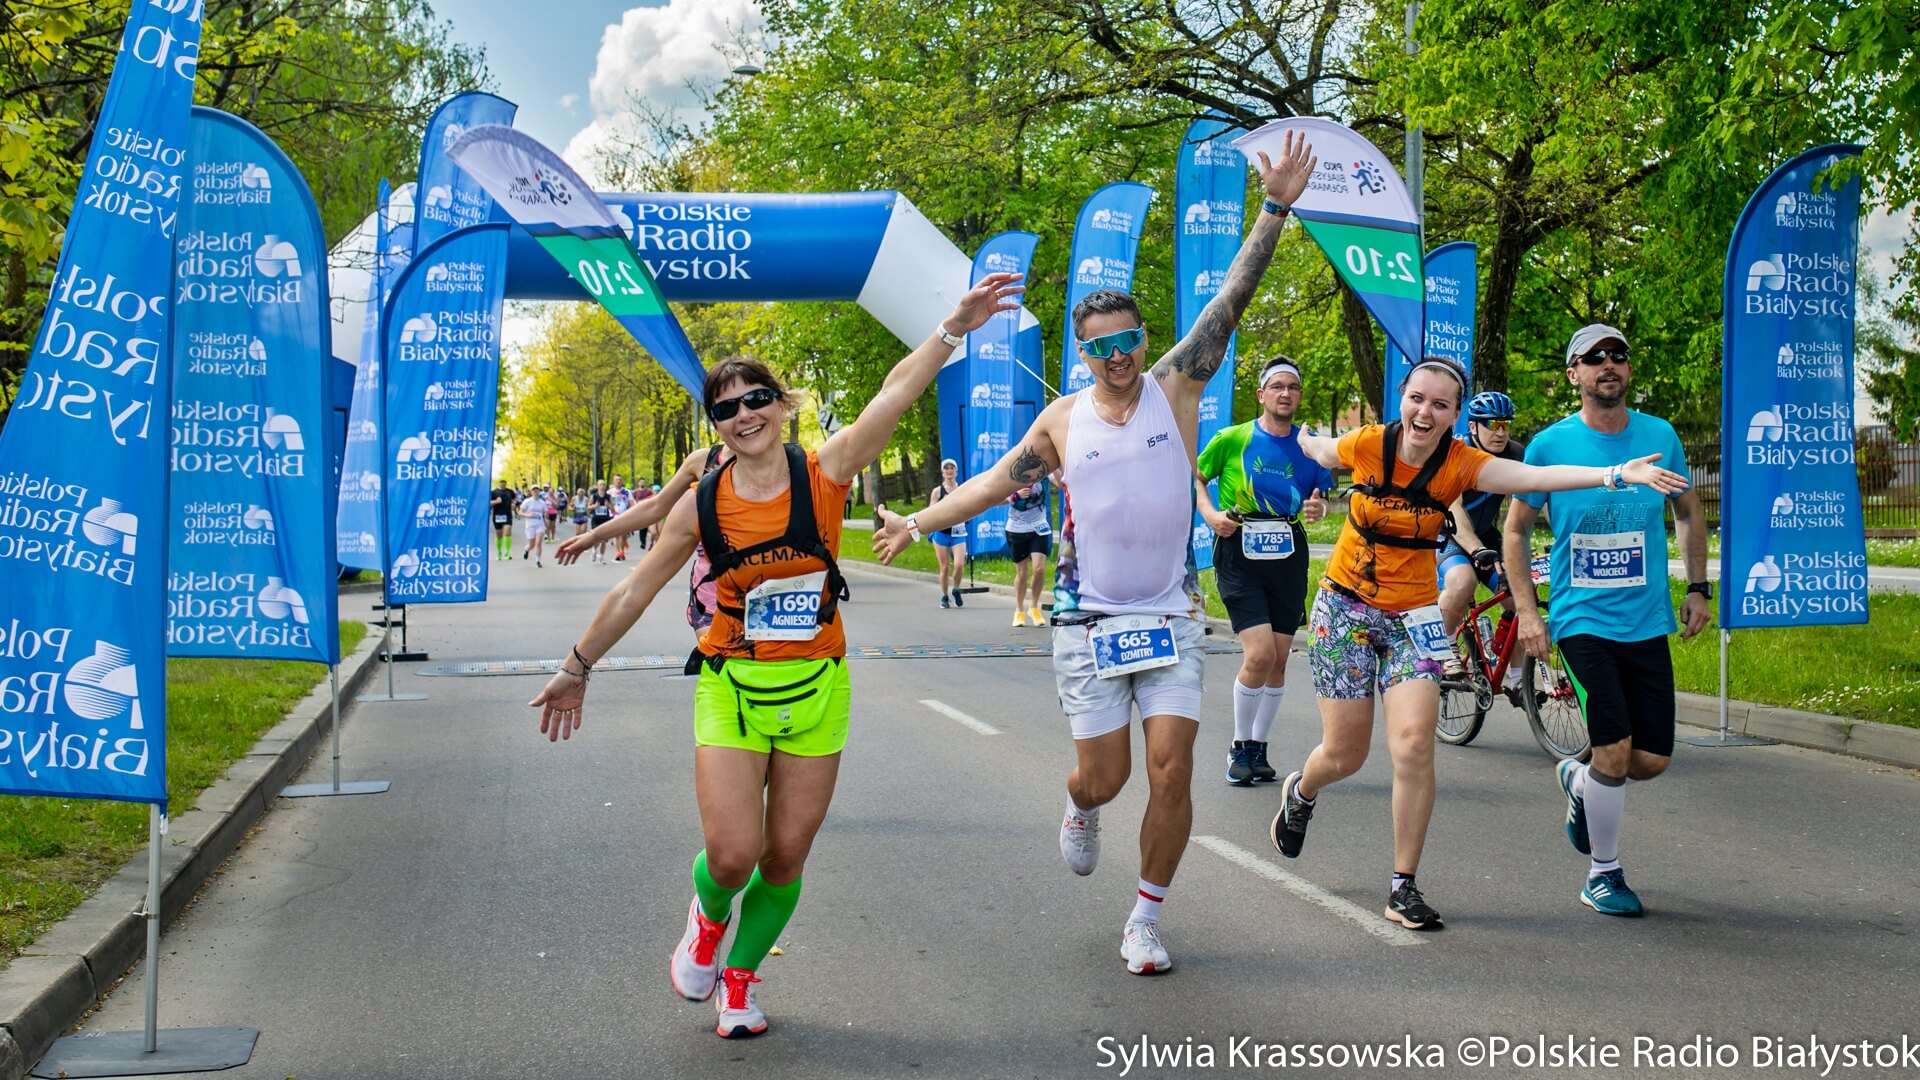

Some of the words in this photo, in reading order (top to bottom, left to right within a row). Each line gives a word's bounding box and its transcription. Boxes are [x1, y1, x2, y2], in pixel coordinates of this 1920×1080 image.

[638, 203, 752, 222] Polskie
[637, 223, 752, 251] Radio
[449, 262, 485, 272] Polskie
[448, 272, 485, 282] Radio
[439, 310, 495, 325] Polskie
[437, 325, 494, 343] Radio
[400, 343, 493, 365] Białystok
[1795, 341, 1843, 352] Polskie
[1795, 352, 1843, 365] Radio
[1777, 365, 1843, 381] Białystok
[433, 426, 488, 443] Polskie
[1784, 421, 1852, 443] Radi
[431, 442, 486, 460] Radio
[396, 460, 485, 482] Białystok
[1795, 491, 1845, 502] Polskie
[1795, 502, 1845, 515] Radio
[1770, 515, 1845, 531] Białystok
[1256, 533, 1284, 544] 1785
[422, 544, 482, 560] Polskie
[1591, 550, 1630, 566] 1930
[418, 559, 481, 577] Radio
[1784, 551, 1866, 570] Polskie
[1593, 567, 1628, 577] WOJCIECH
[390, 577, 481, 598] Białystok
[1784, 570, 1866, 592] Radio
[772, 594, 820, 612] 1690
[1742, 592, 1866, 619] Białystok
[1424, 623, 1446, 638] 181
[1118, 632, 1151, 649] 665
[1121, 647, 1154, 662] DZMITRY
